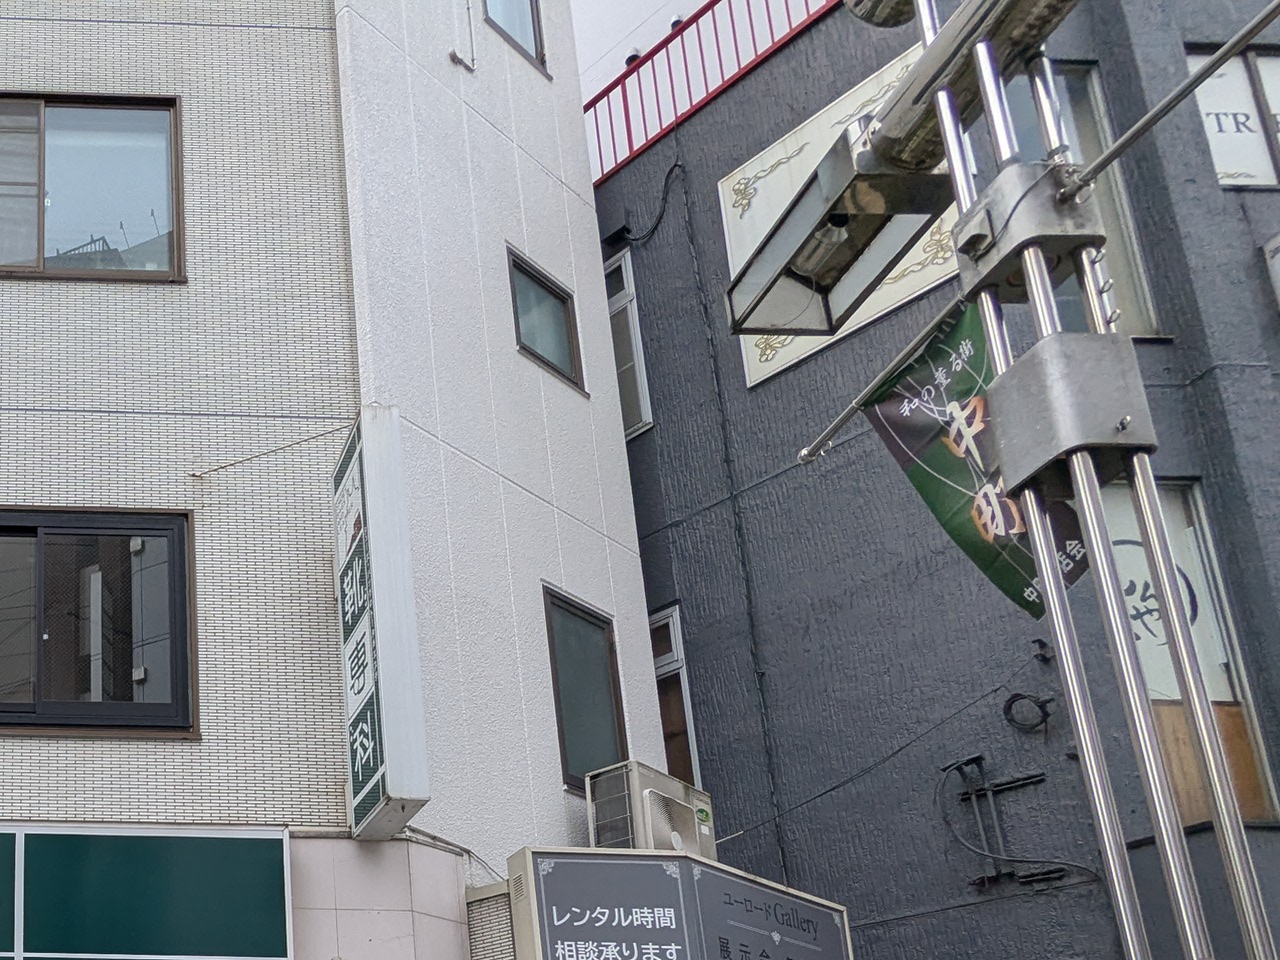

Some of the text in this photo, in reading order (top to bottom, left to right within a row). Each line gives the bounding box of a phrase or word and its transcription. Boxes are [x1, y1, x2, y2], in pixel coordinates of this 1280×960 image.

[342, 555, 376, 782] 靴専科
[550, 905, 676, 929] レンタル時間
